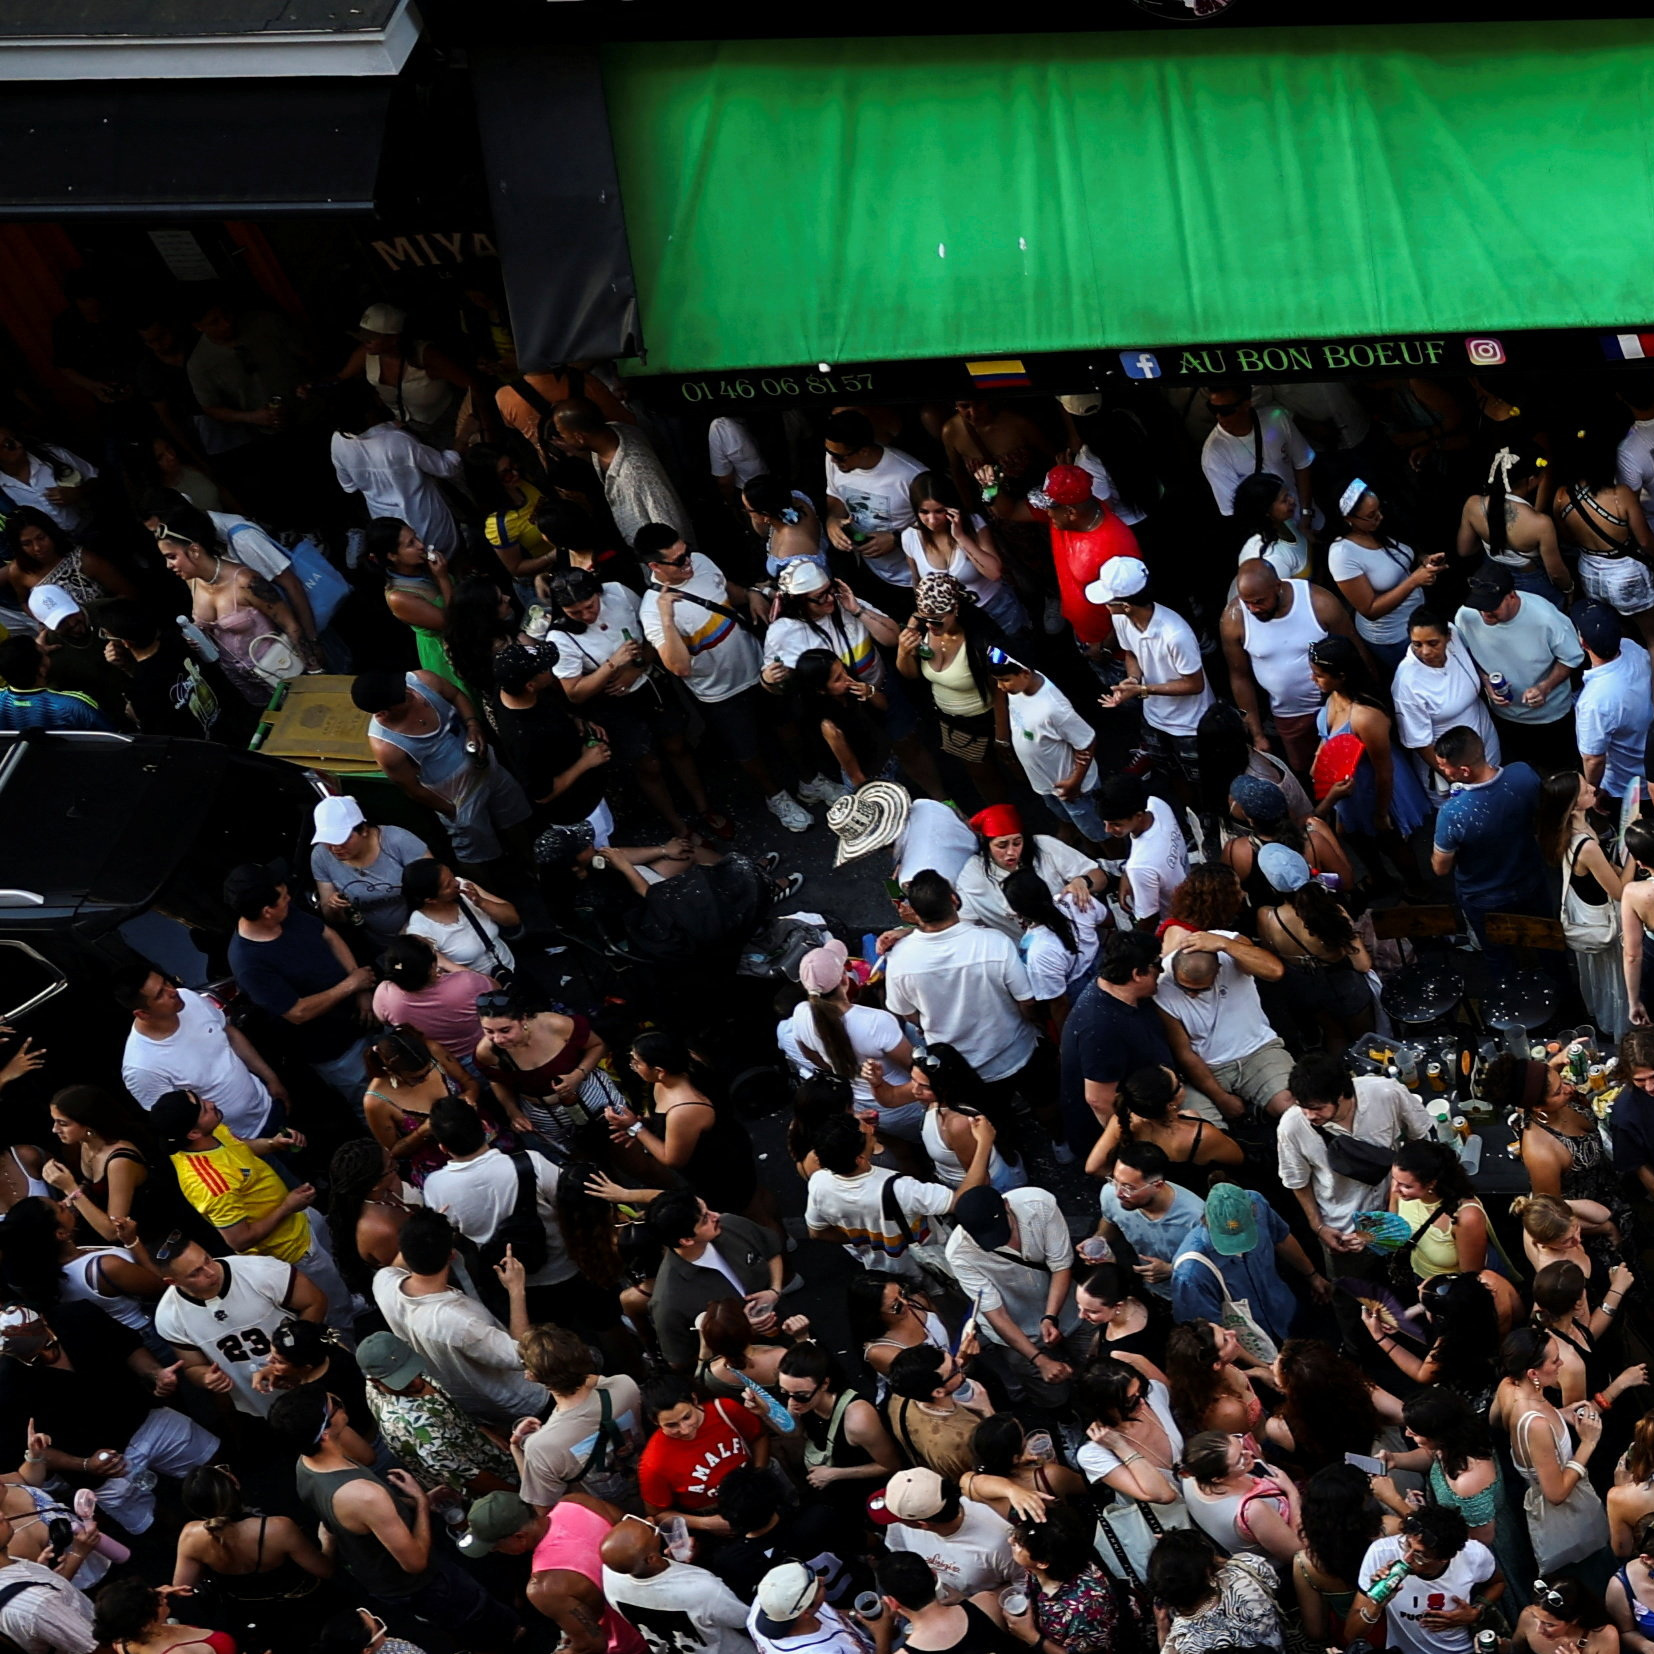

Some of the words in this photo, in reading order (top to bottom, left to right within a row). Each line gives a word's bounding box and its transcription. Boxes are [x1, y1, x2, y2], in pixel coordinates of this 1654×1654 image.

[1178, 350, 1227, 375] AU
[1237, 347, 1313, 372] BON
[682, 382, 713, 402] 01
[719, 378, 755, 400] 46
[761, 376, 800, 396] 06
[805, 374, 836, 395] 81
[841, 373, 875, 392] 57
[216, 1328, 271, 1362] 23
